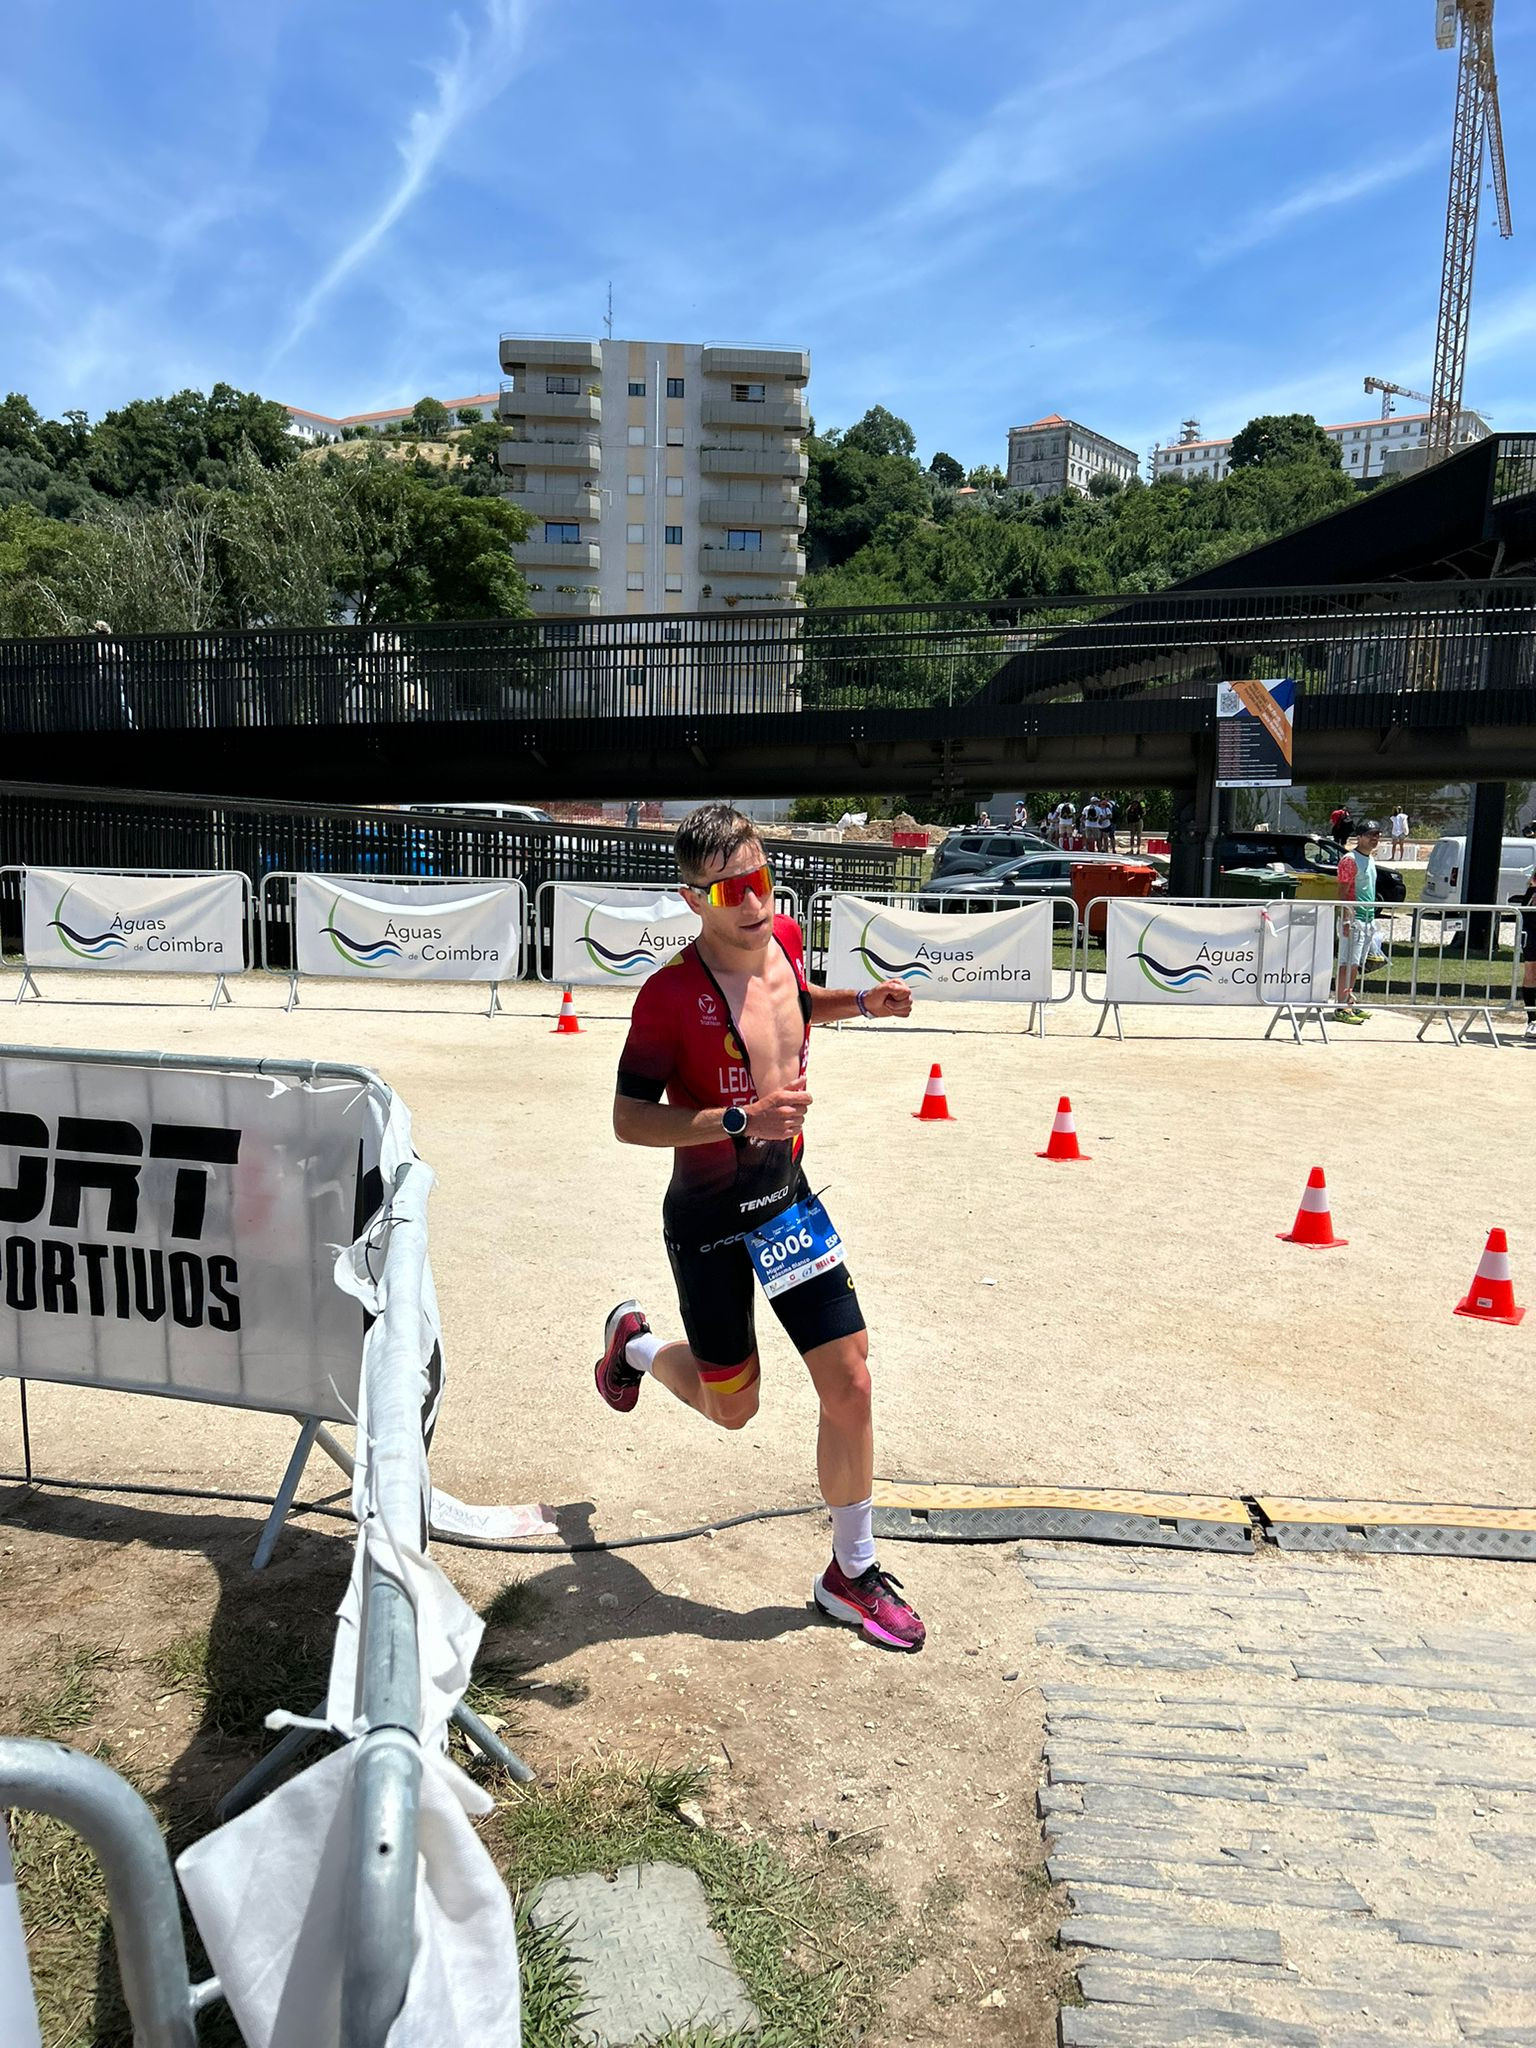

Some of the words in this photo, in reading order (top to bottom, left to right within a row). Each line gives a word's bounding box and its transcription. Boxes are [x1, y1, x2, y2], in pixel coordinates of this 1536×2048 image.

[110, 912, 166, 934] Águas
[384, 919, 442, 943] Águas
[133, 943, 144, 952] de
[147, 935, 223, 953] Coimbra
[408, 952, 419, 961] de
[421, 944, 499, 962] Coimbra
[915, 942, 974, 965] Águas
[1196, 942, 1254, 965] Águas
[938, 974, 949, 983] de
[951, 964, 1031, 983] Coimbra
[1217, 976, 1229, 985] de
[1231, 967, 1311, 985] Combra
[719, 1066, 755, 1093] LED
[739, 1185, 789, 1213] TENNECO
[760, 1228, 813, 1268] 6006
[0, 1235, 241, 1332] ORTIVOS
